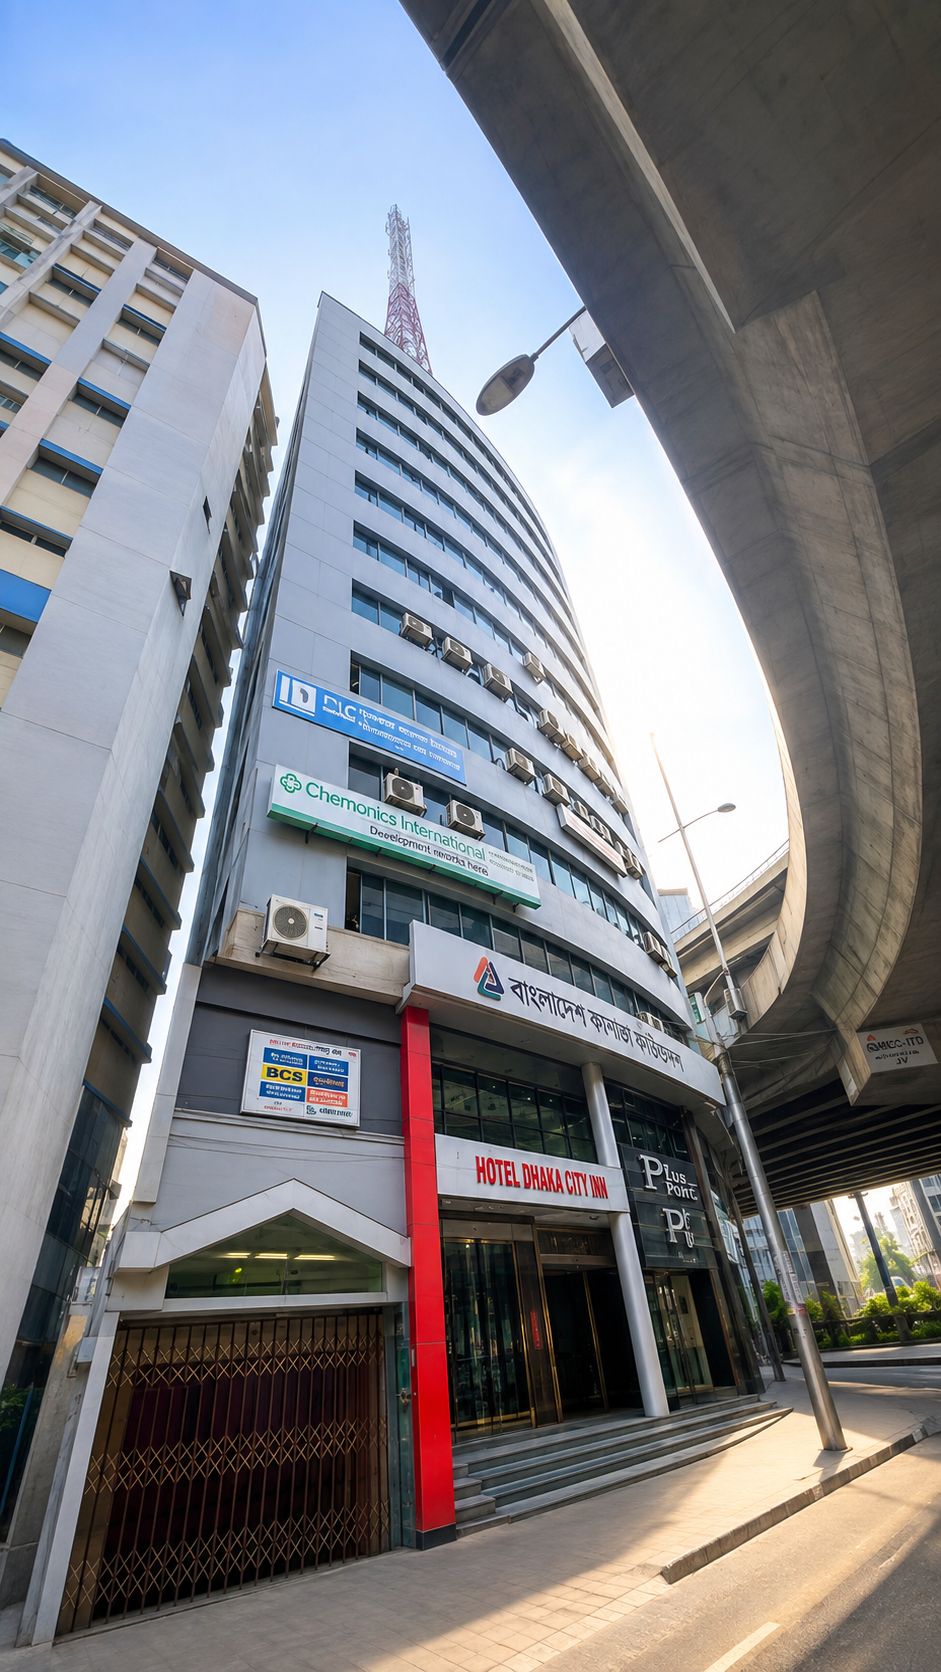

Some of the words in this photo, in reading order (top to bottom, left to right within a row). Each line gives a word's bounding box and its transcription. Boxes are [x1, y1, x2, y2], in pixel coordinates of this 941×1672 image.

[306, 782, 397, 826] Chemonics
[400, 815, 486, 861] International
[508, 977, 587, 1027] বাংলাদেশ
[266, 1066, 303, 1083] BCS
[475, 1155, 520, 1188] HOTEL
[521, 1163, 564, 1194] DHAKA
[565, 1170, 589, 1198] CITY
[589, 1175, 609, 1200] INN
